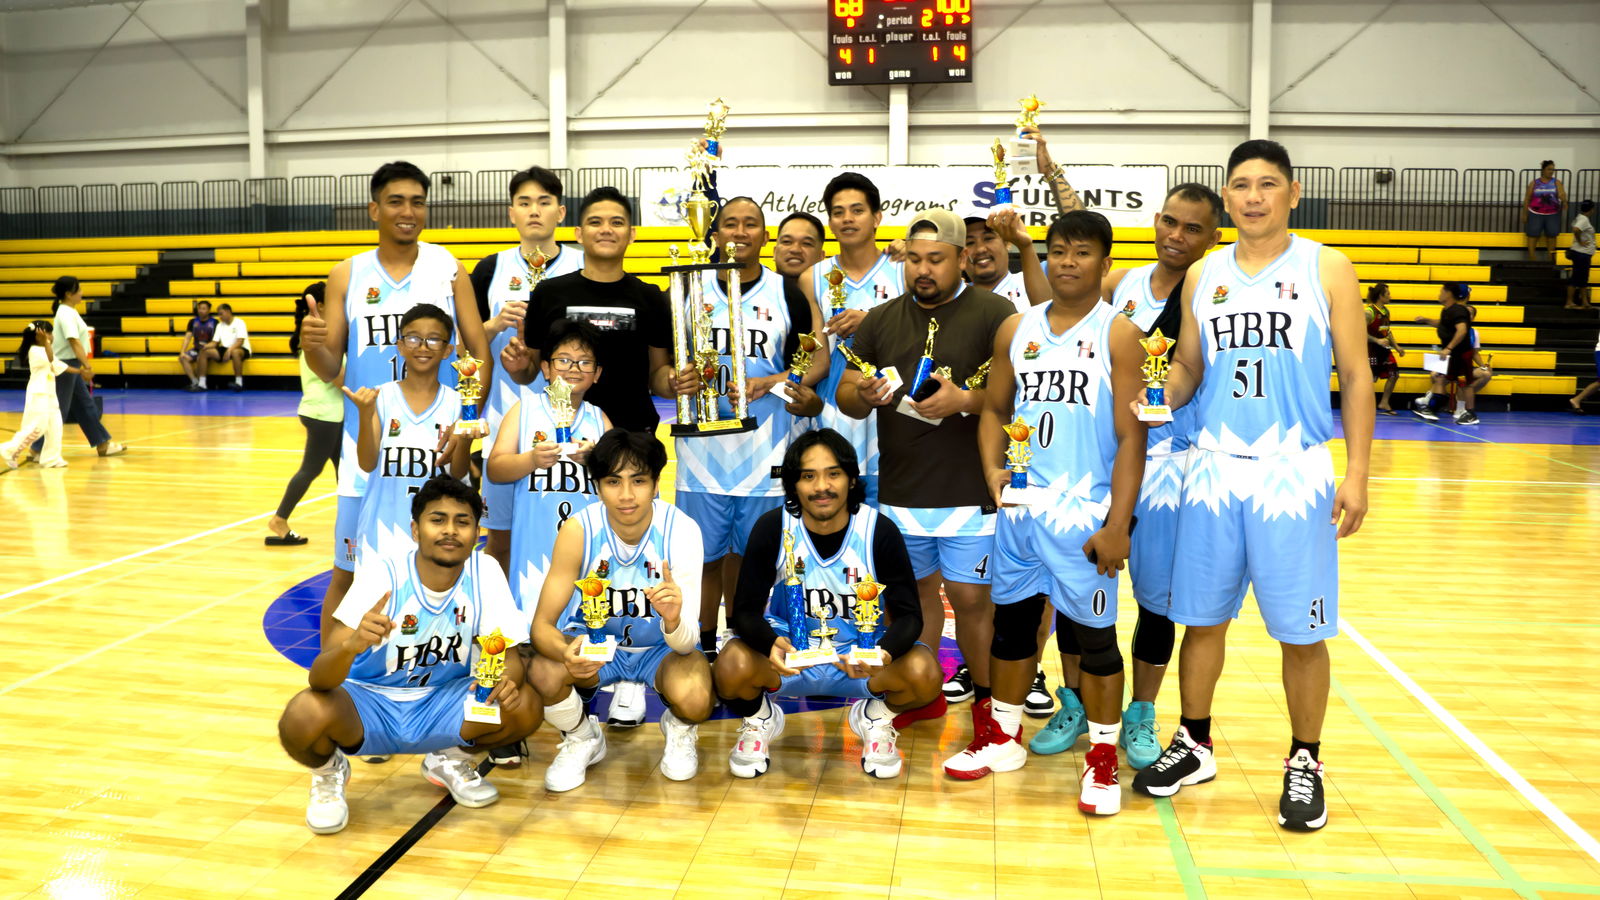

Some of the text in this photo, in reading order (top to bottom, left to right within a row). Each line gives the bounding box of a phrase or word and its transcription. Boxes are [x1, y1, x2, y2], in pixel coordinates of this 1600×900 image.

[886, 15, 913, 27] period
[921, 9, 933, 27] 2
[833, 34, 853, 44] fouls
[886, 32, 914, 43] player
[946, 31, 967, 41] fouls
[839, 48, 852, 64] 4
[868, 48, 875, 64] 1
[953, 45, 966, 62] 4
[835, 71, 852, 79] won
[889, 70, 911, 80] game
[948, 69, 966, 77] won
[1210, 311, 1293, 352] HBR
[1232, 358, 1266, 399] 51
[1019, 370, 1091, 406] HBR
[1037, 411, 1054, 449] 0
[974, 554, 989, 579] 4
[1092, 589, 1107, 617] 0
[1308, 597, 1327, 629] 51
[391, 632, 462, 674] HBR
